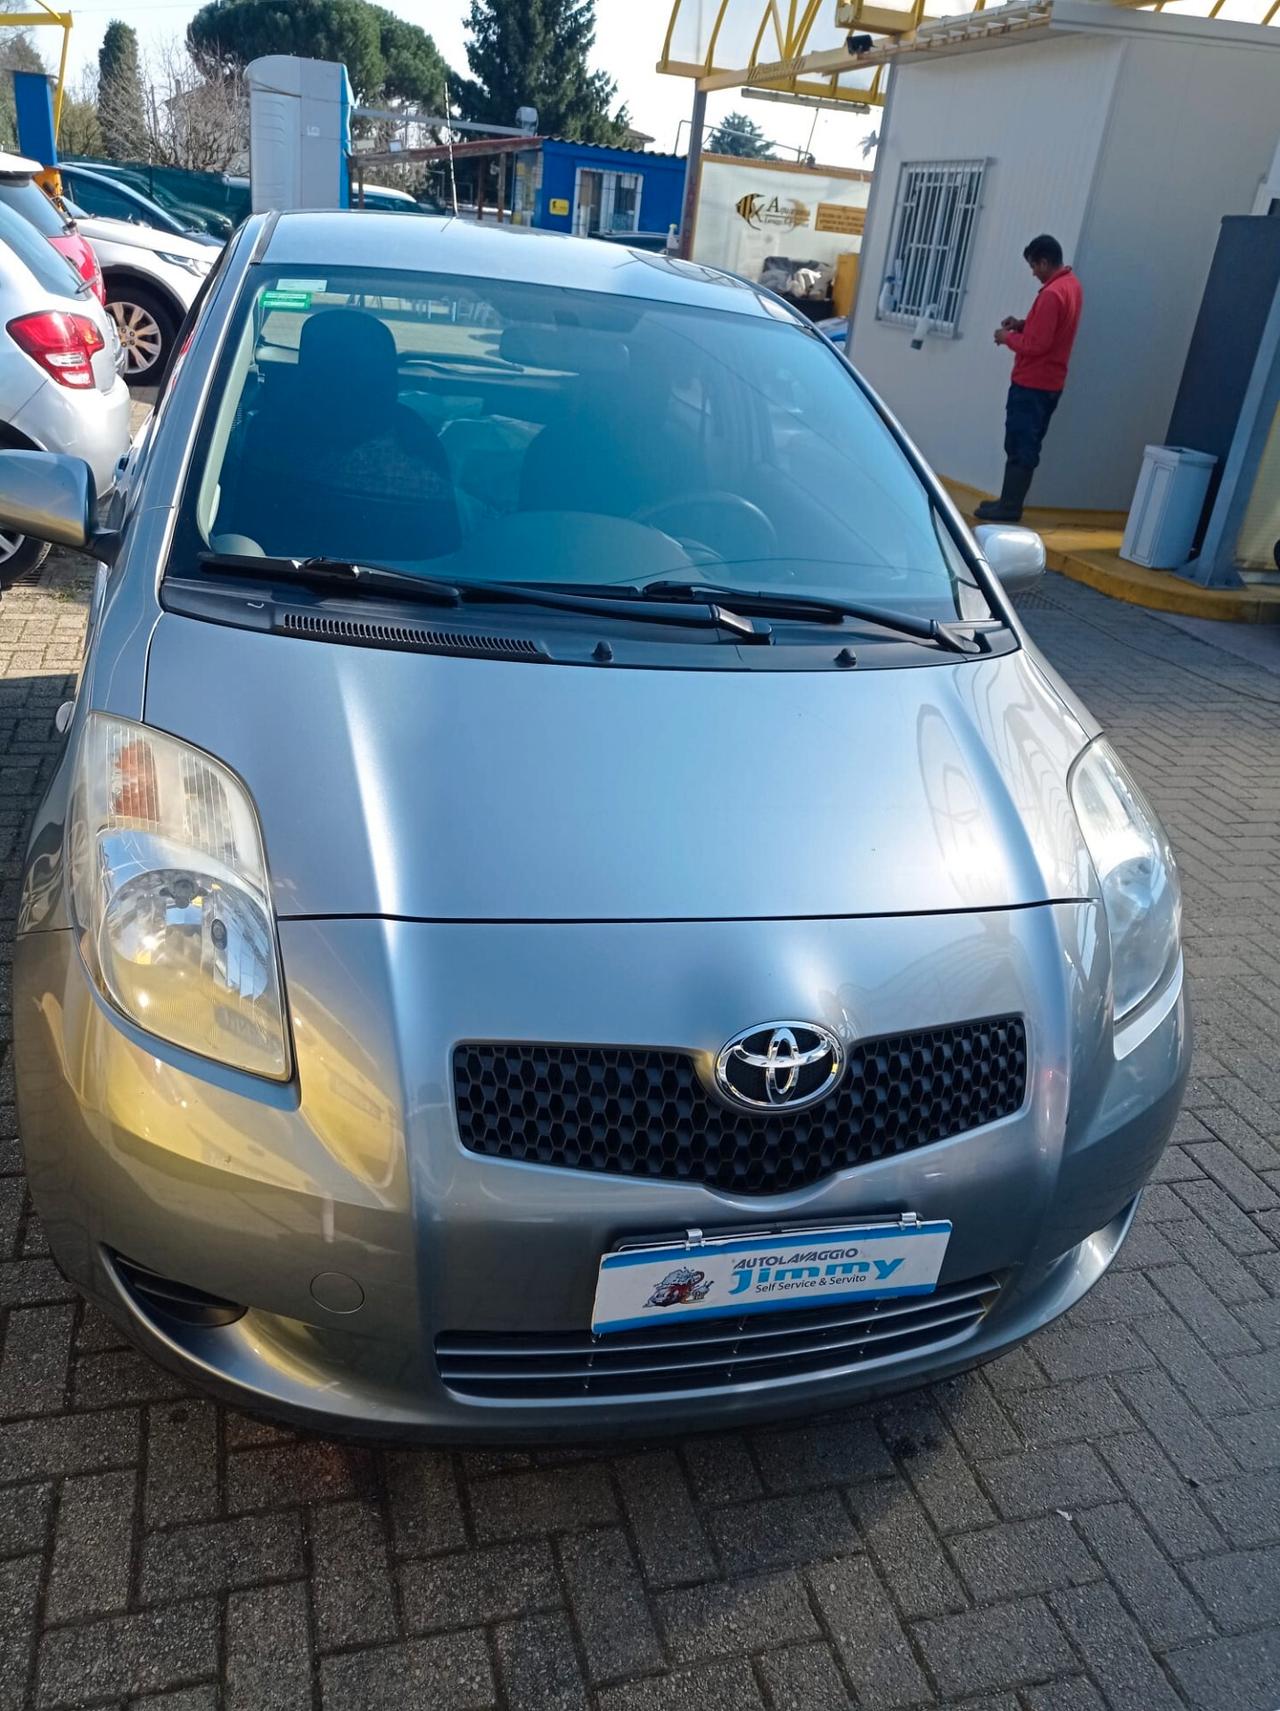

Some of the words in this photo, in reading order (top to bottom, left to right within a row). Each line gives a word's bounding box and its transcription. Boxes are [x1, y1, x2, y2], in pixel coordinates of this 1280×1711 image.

[733, 1248, 858, 1270] AUTOLAVAGGIO
[755, 1282, 776, 1294] Self
[779, 1278, 816, 1291] Service
[818, 1278, 826, 1286] &
[829, 1274, 866, 1286] Servito
